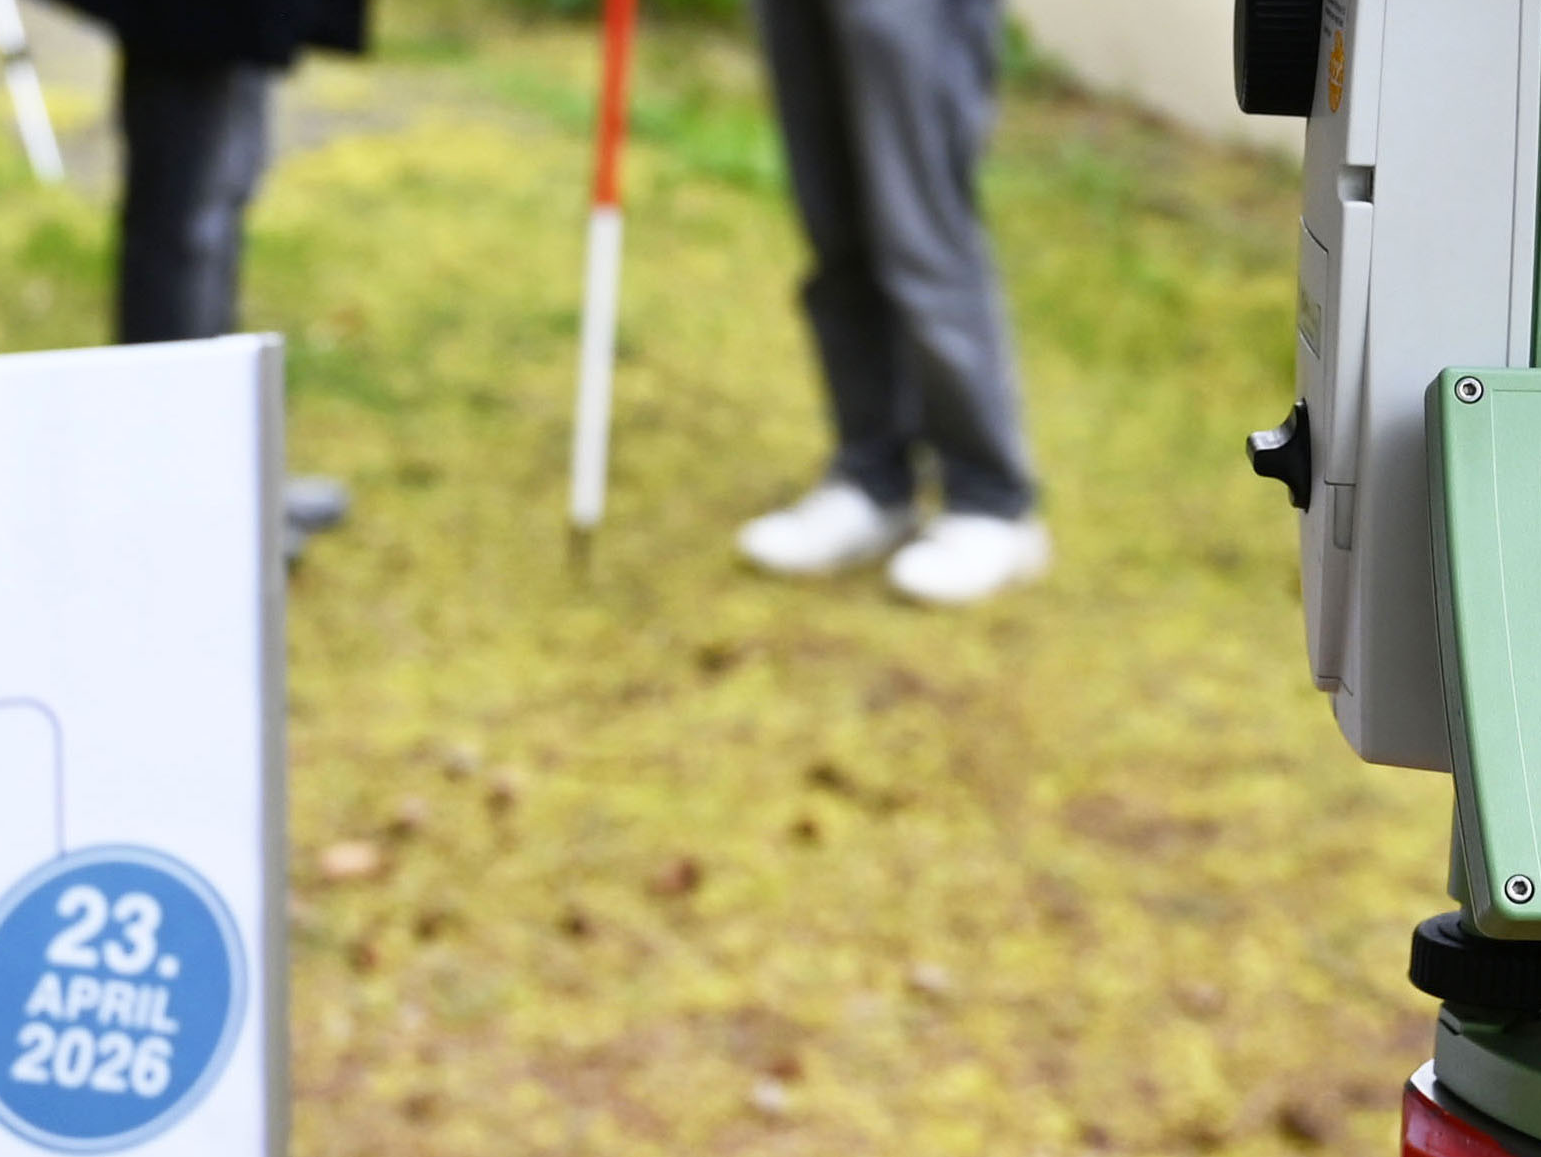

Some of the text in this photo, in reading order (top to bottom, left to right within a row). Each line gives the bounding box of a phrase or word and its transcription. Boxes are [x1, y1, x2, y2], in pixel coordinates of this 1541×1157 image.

[45, 884, 181, 979] 23.
[25, 970, 180, 1035] APRIL
[11, 1020, 174, 1099] 2026
